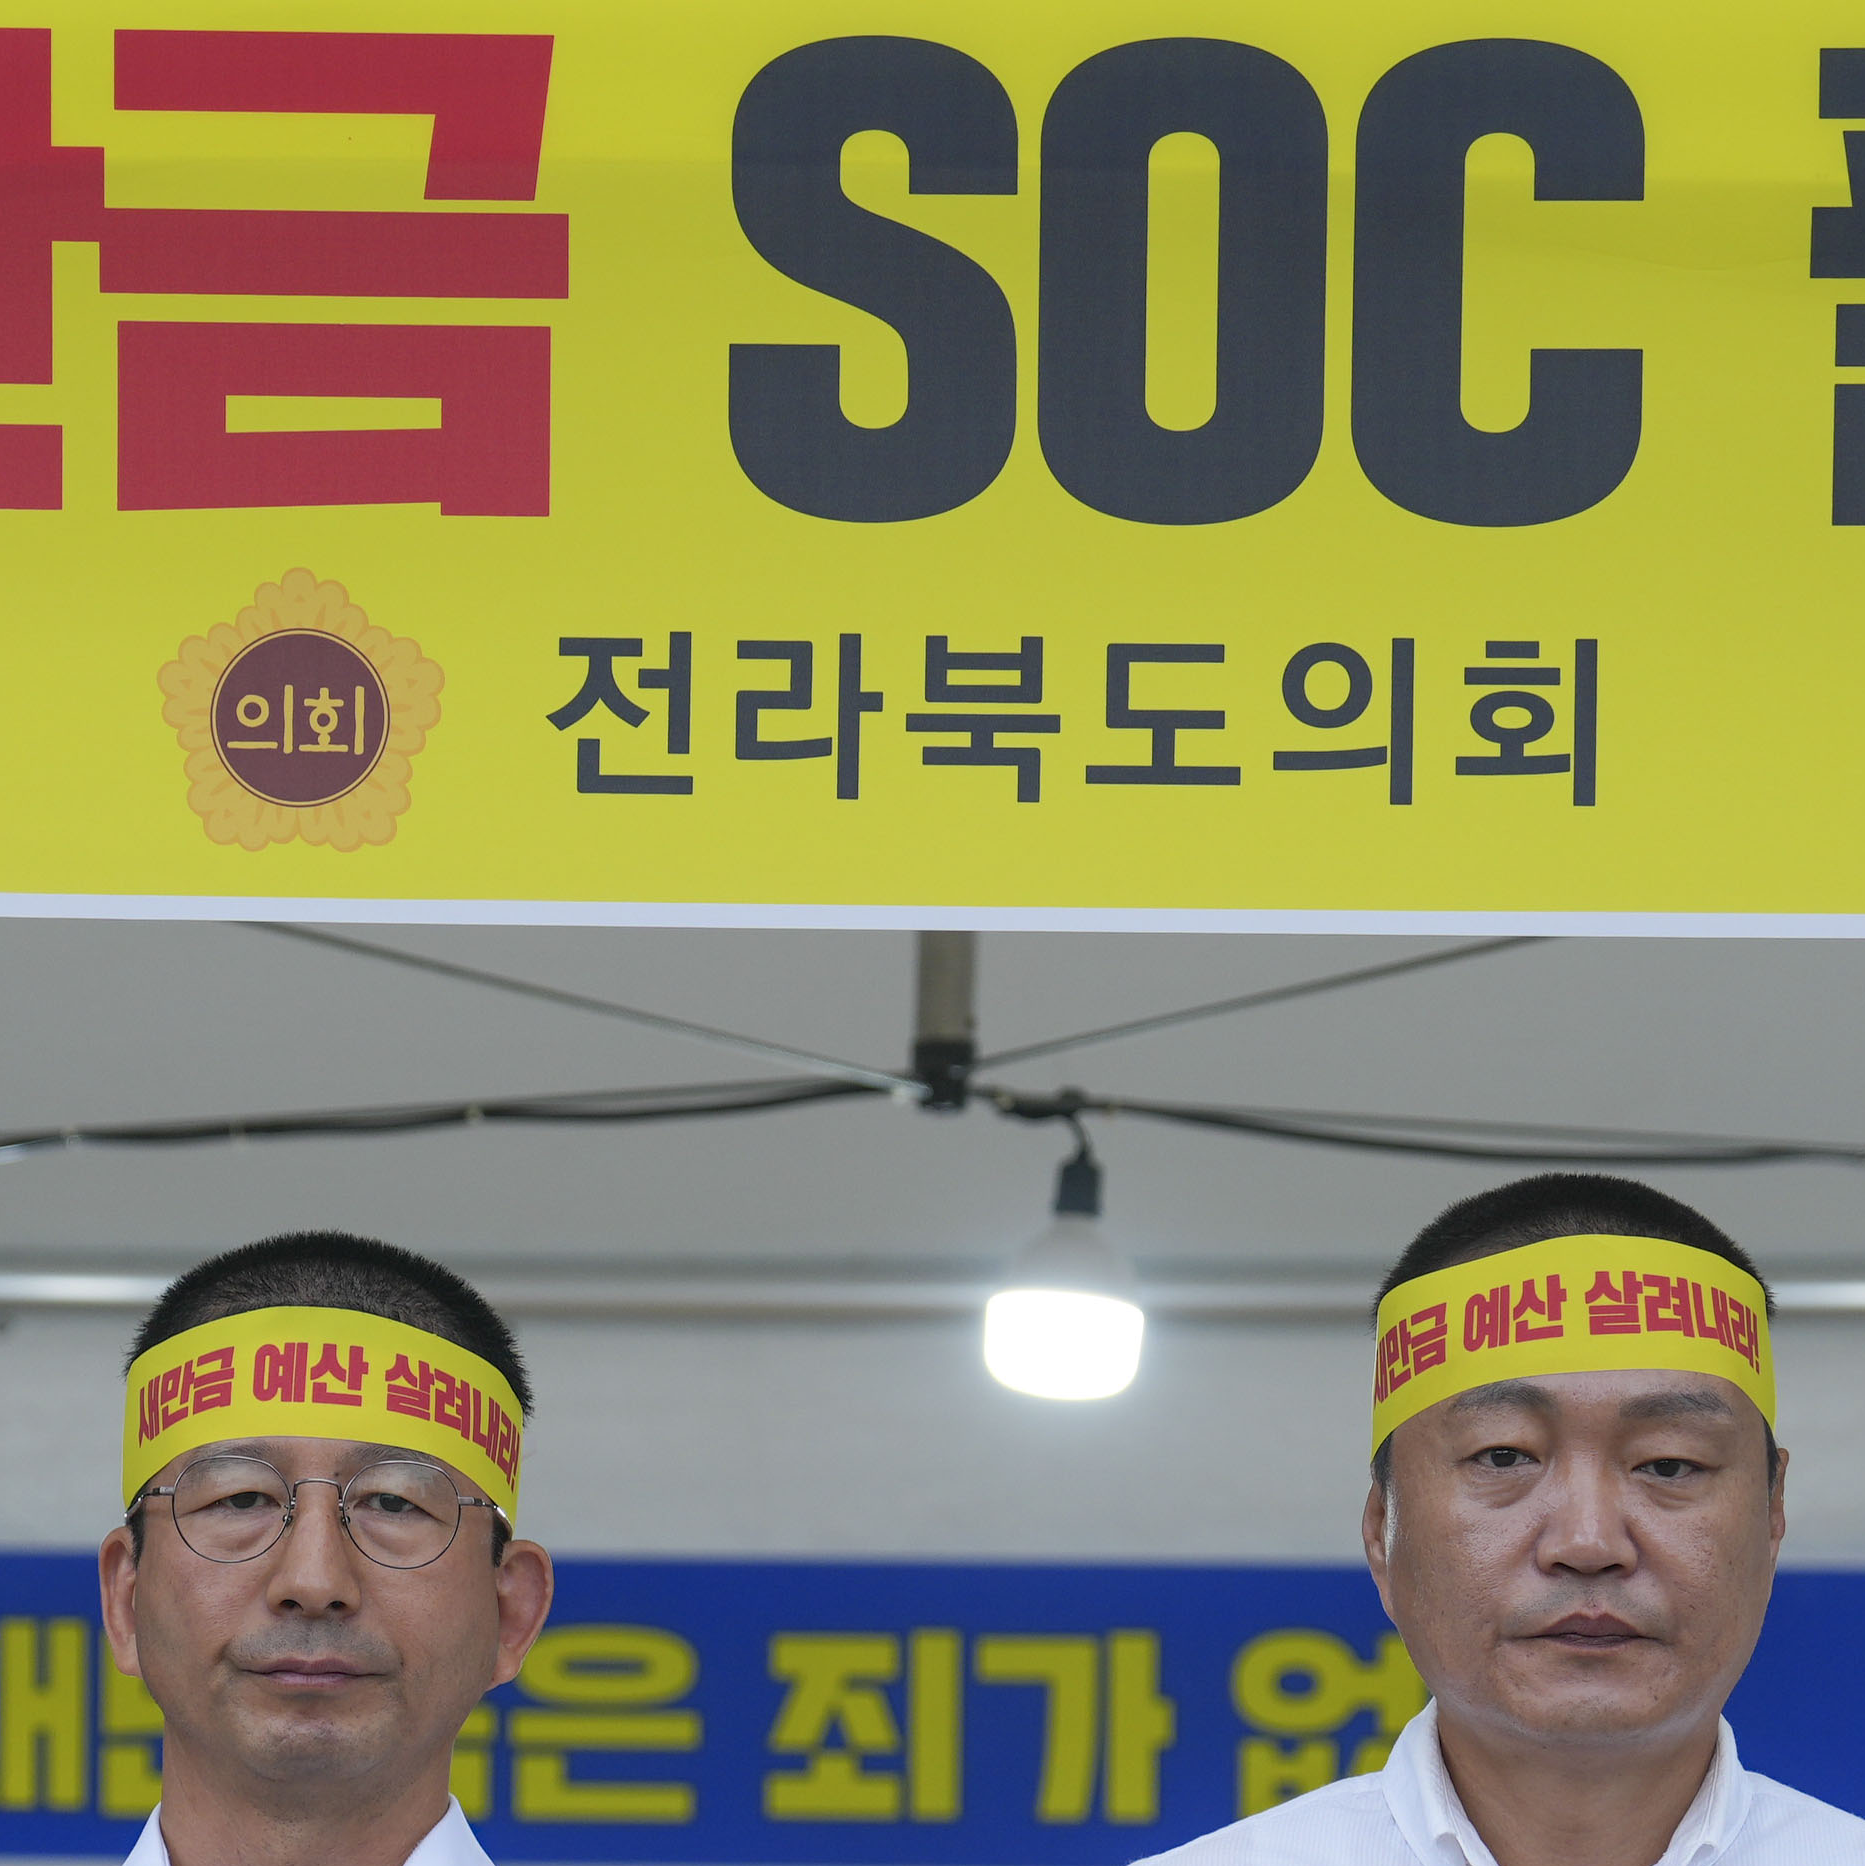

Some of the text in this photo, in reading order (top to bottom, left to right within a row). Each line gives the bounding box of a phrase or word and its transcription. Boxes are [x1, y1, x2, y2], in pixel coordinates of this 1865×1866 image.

[729, 35, 1646, 528] SOC
[226, 684, 368, 757] 의회
[546, 632, 1598, 807] 전라북도의회
[138, 1341, 520, 1495] 새만금 예산 살려내라!
[1374, 1270, 1761, 1410] 새만금 예산 살려내라!
[764, 1608, 1175, 1826] 죄가
